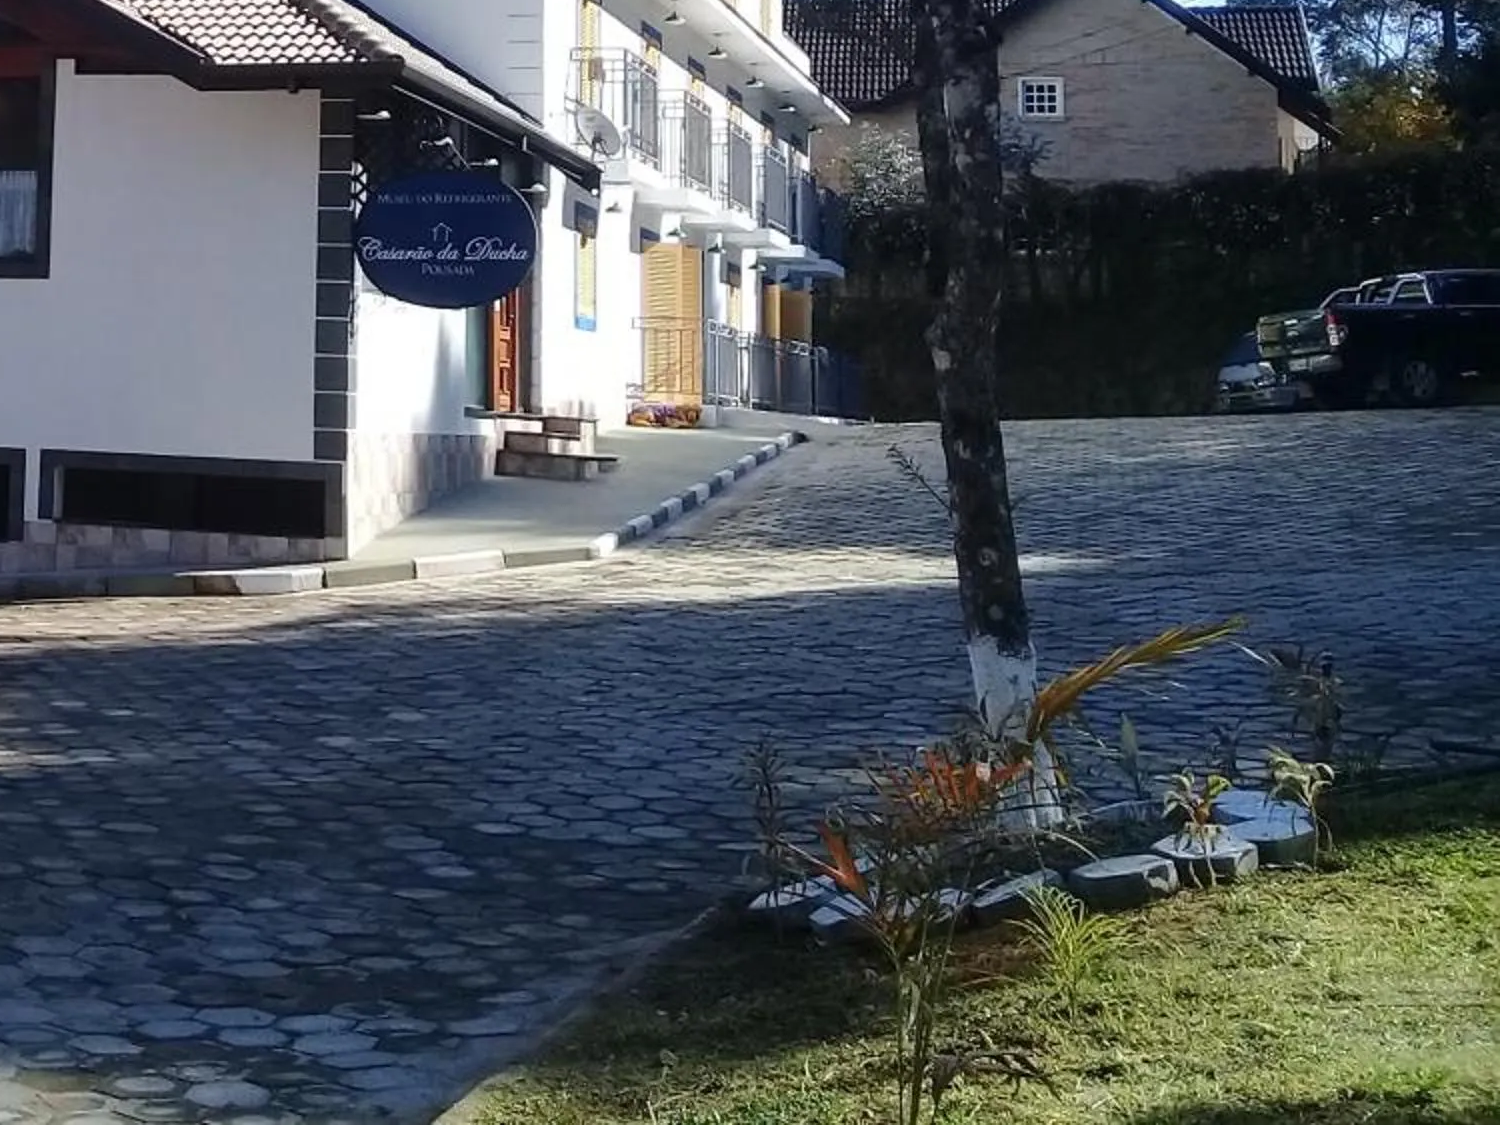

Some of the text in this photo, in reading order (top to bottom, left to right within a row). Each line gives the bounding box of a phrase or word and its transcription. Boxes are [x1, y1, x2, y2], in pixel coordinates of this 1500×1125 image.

[357, 236, 529, 261] Casarão da Ducha
